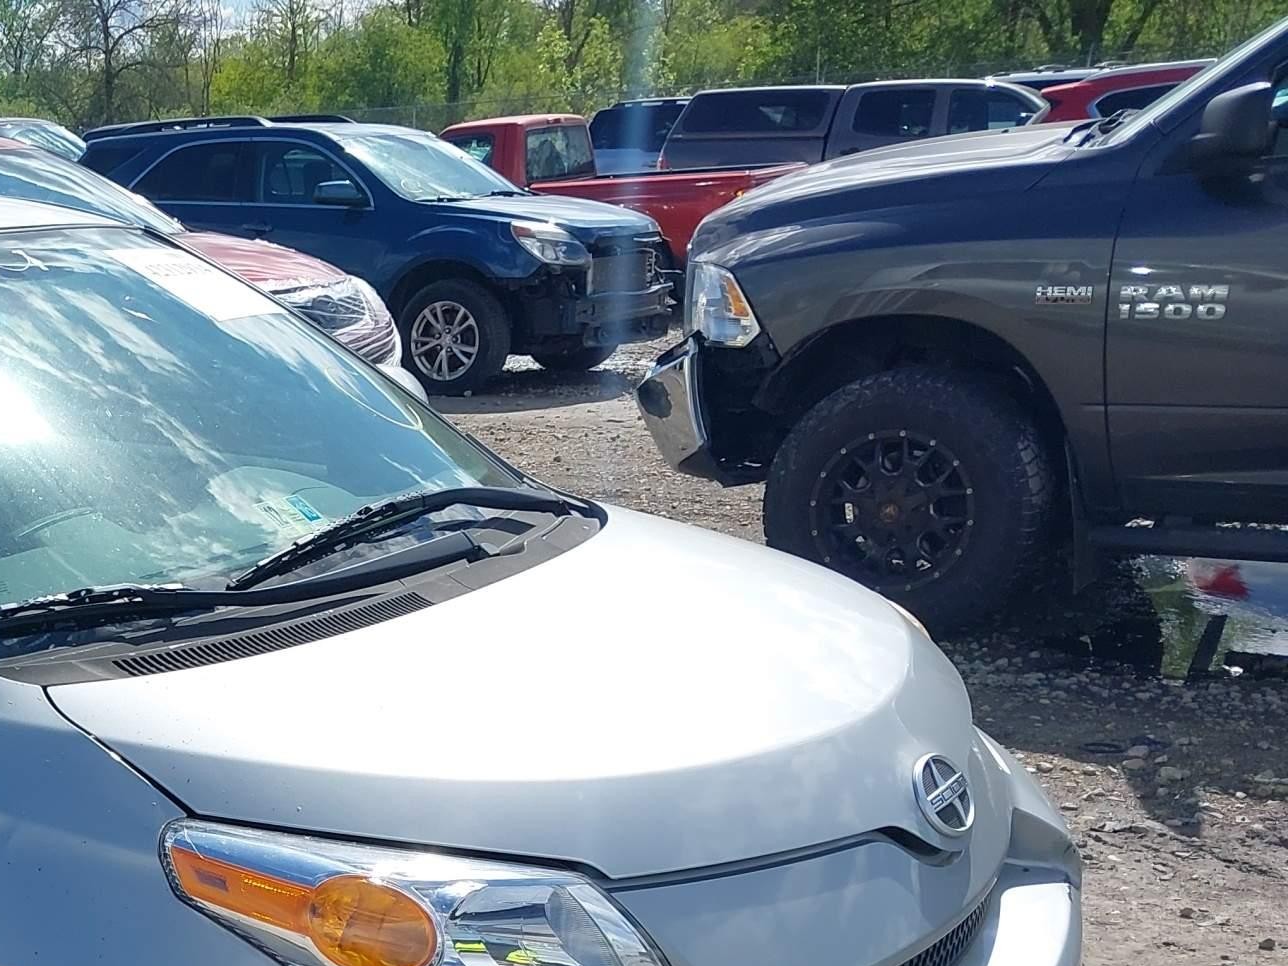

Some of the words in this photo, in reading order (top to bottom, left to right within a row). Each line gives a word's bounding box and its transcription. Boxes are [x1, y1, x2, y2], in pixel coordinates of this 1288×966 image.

[1036, 285, 1093, 297] HEMI
[1119, 284, 1230, 301] RAM
[1118, 302, 1227, 320] 1500
